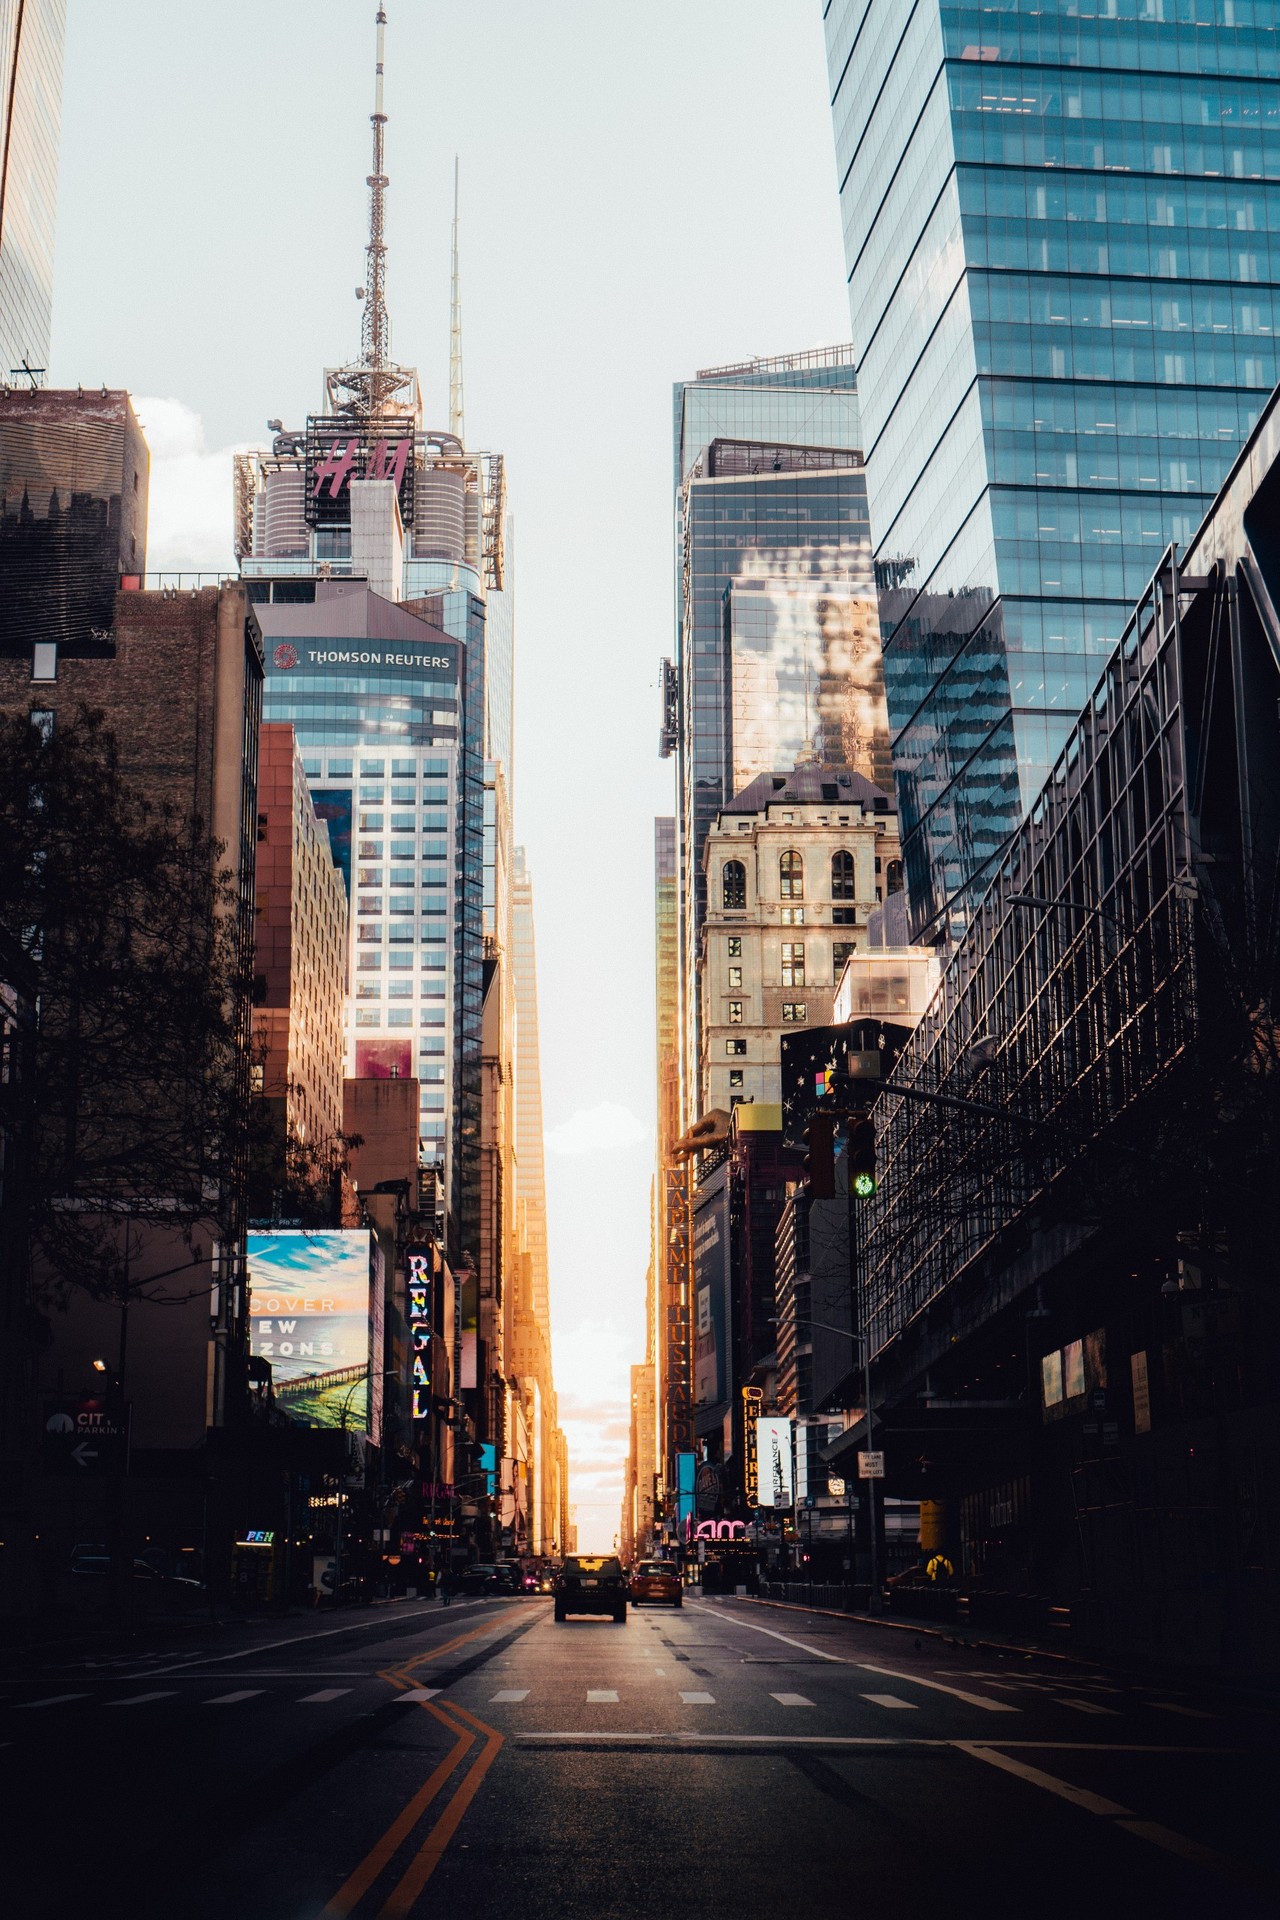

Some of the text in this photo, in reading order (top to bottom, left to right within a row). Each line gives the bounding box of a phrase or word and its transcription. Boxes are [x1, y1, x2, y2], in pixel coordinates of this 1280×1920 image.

[308, 651, 450, 668] THOMSON REUTERS
[408, 1255, 430, 1419] REGAL
[77, 1412, 111, 1426] CIT
